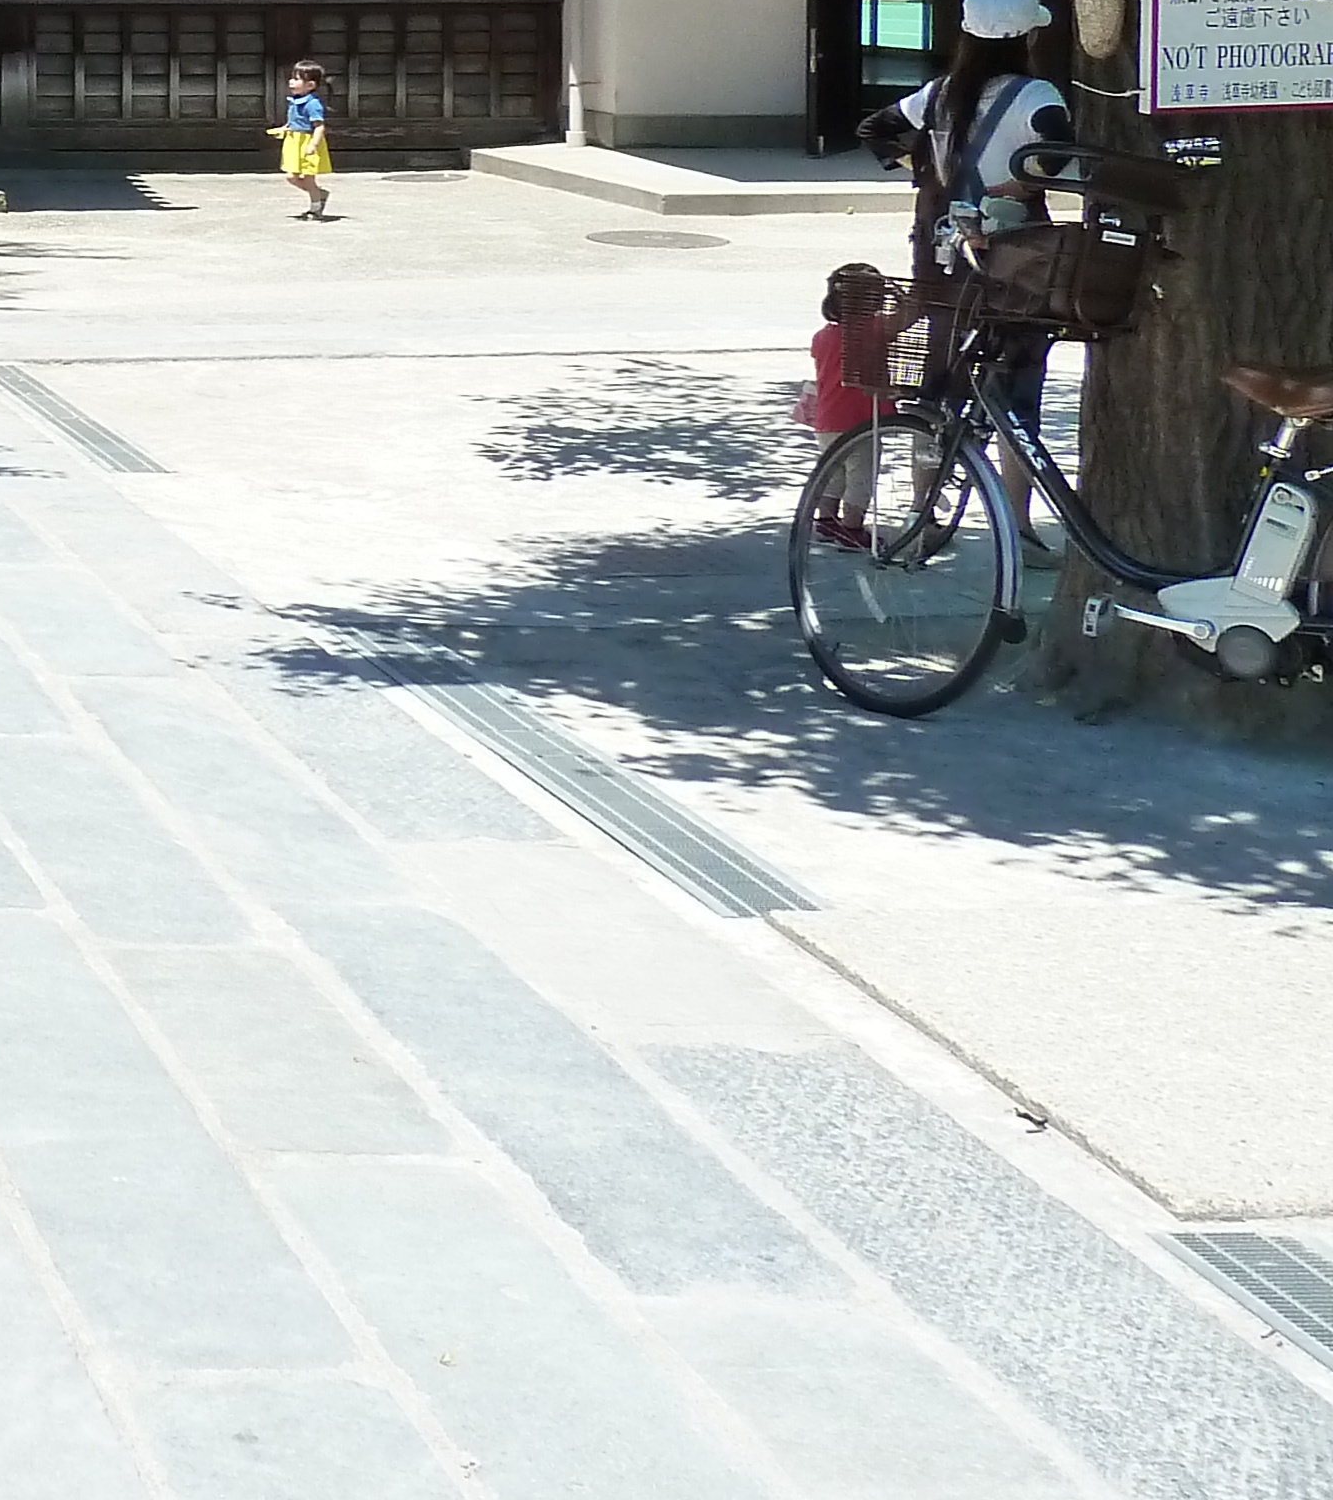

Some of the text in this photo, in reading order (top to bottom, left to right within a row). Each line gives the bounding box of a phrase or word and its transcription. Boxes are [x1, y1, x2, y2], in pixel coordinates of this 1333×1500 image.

[1205, 6, 1310, 28] ご遠慮下さい
[1161, 42, 1208, 71] NO'T
